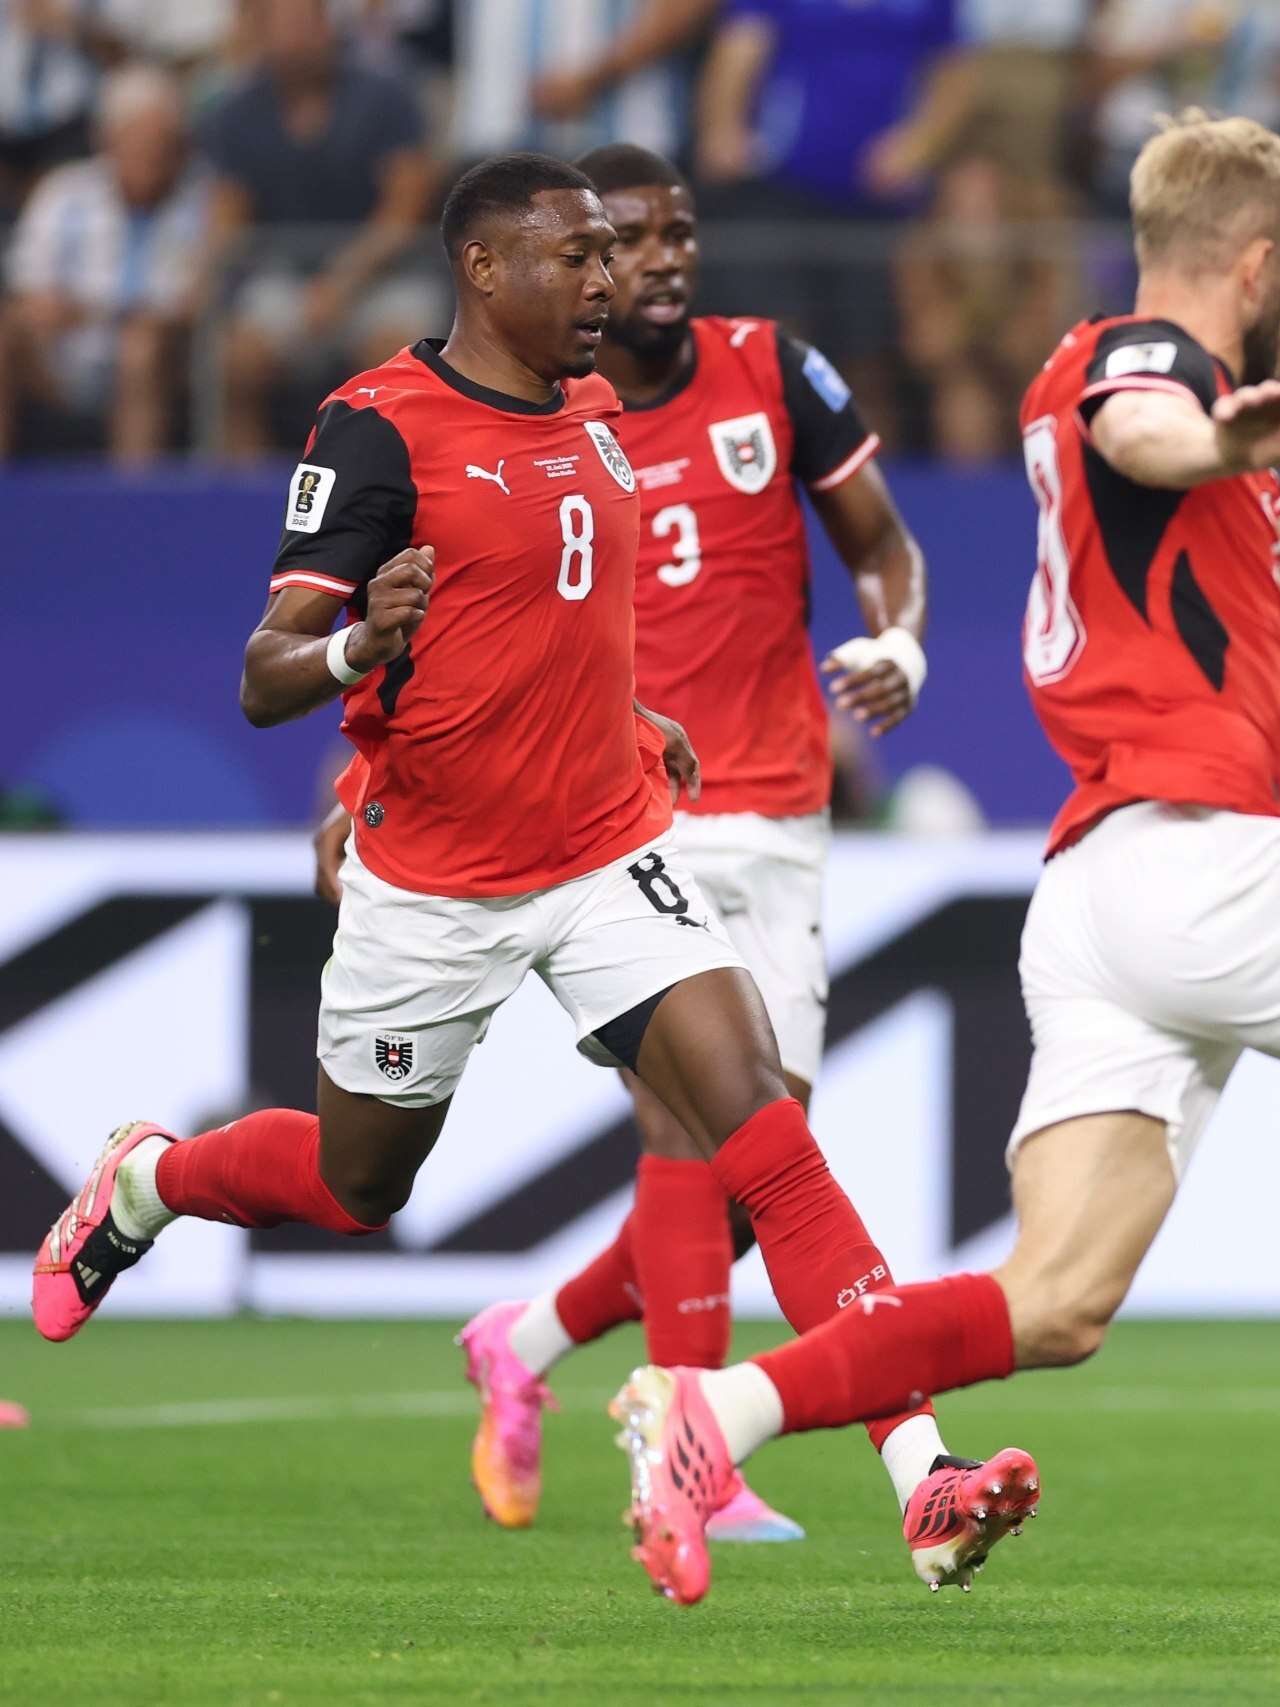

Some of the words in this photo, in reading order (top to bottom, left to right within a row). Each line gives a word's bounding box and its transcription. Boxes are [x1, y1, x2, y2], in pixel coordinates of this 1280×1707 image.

[557, 494, 594, 601] 8
[652, 503, 702, 588] 3
[626, 851, 689, 914] 8
[836, 1264, 887, 1309] ÖFB
